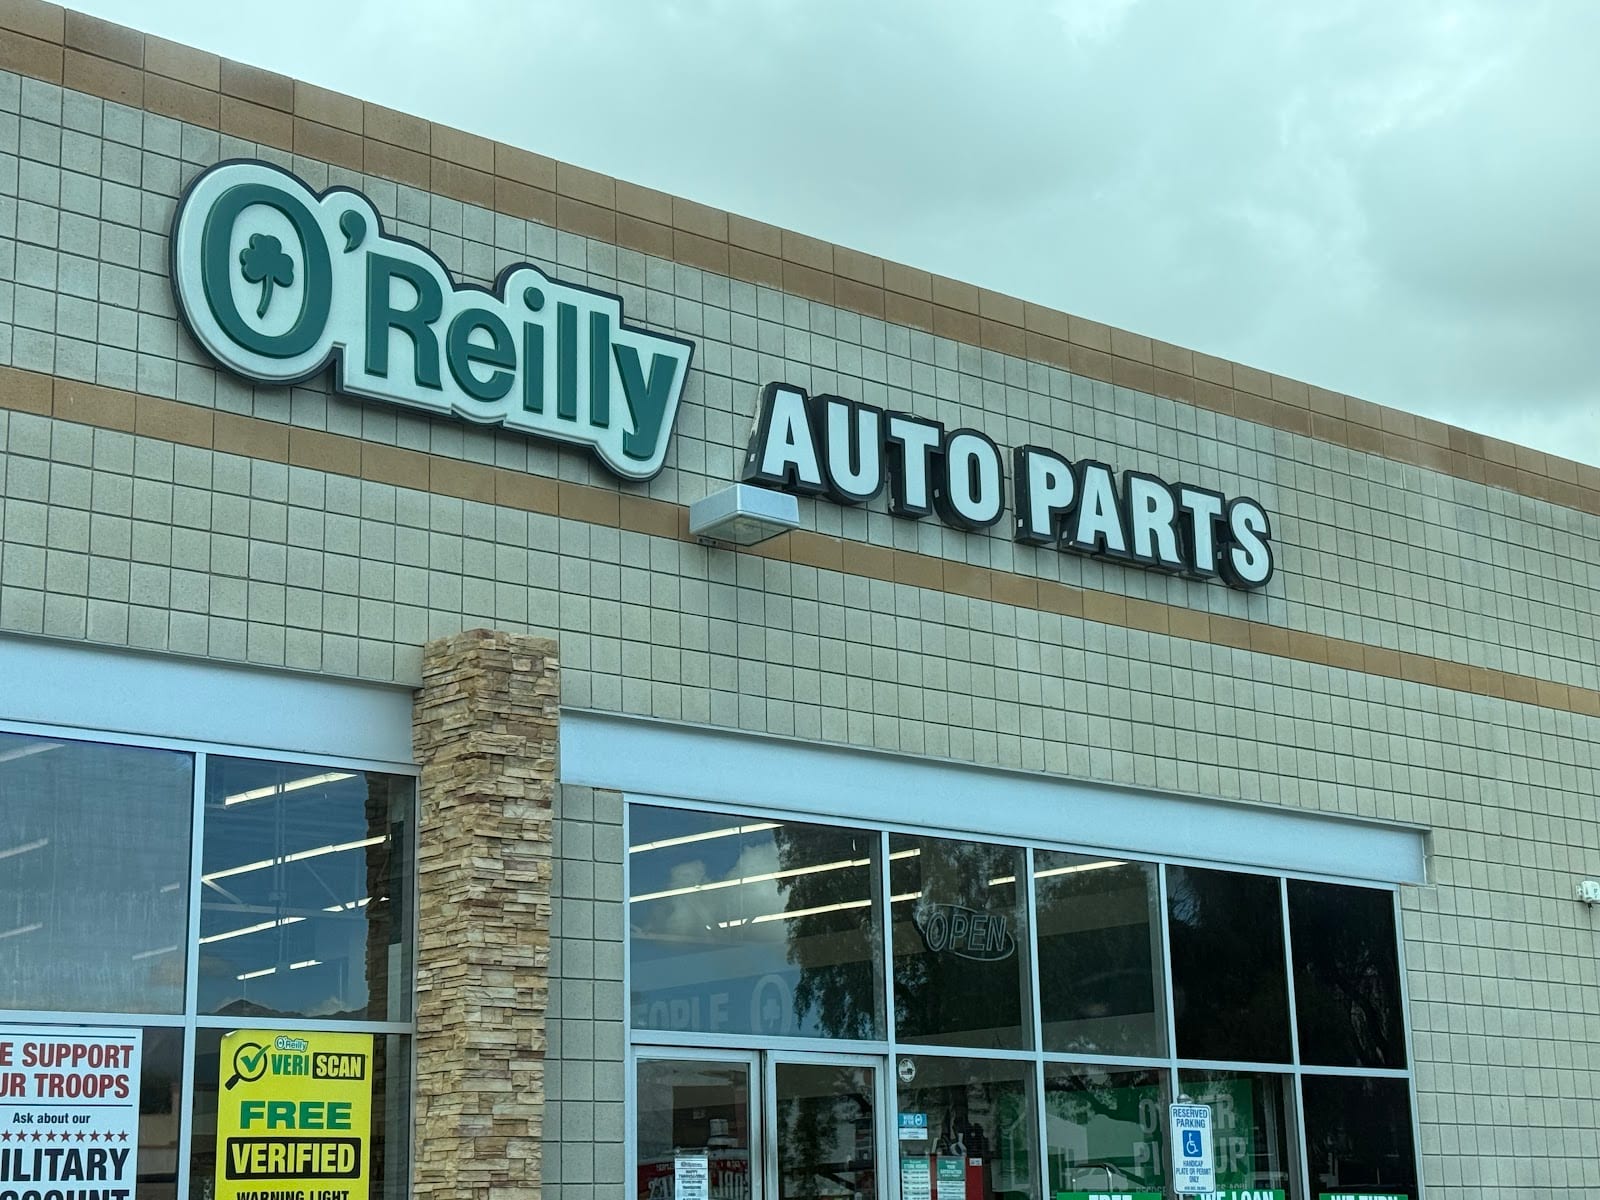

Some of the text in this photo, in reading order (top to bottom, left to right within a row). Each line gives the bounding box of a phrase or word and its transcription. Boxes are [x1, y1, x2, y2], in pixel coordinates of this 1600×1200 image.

[200, 182, 679, 463] O'Reilly
[754, 384, 1273, 588] AUTO PARTS
[926, 911, 1008, 952] OPEN
[22, 1042, 134, 1069] SUPPORT
[275, 1036, 308, 1051] O'Reilly
[271, 1054, 362, 1078] VERI SCAN
[34, 1074, 130, 1099] TROOPS
[13, 1112, 91, 1124] Ask about our
[240, 1100, 352, 1130] FREE
[1173, 1108, 1208, 1119] RESERVED
[1176, 1118, 1206, 1128] PARKING
[231, 1143, 356, 1174] VERIFIED
[1183, 1159, 1204, 1168] HANDICAP
[1175, 1167, 1189, 1175] PLATE
[1189, 1175, 1200, 1183] ONLY
